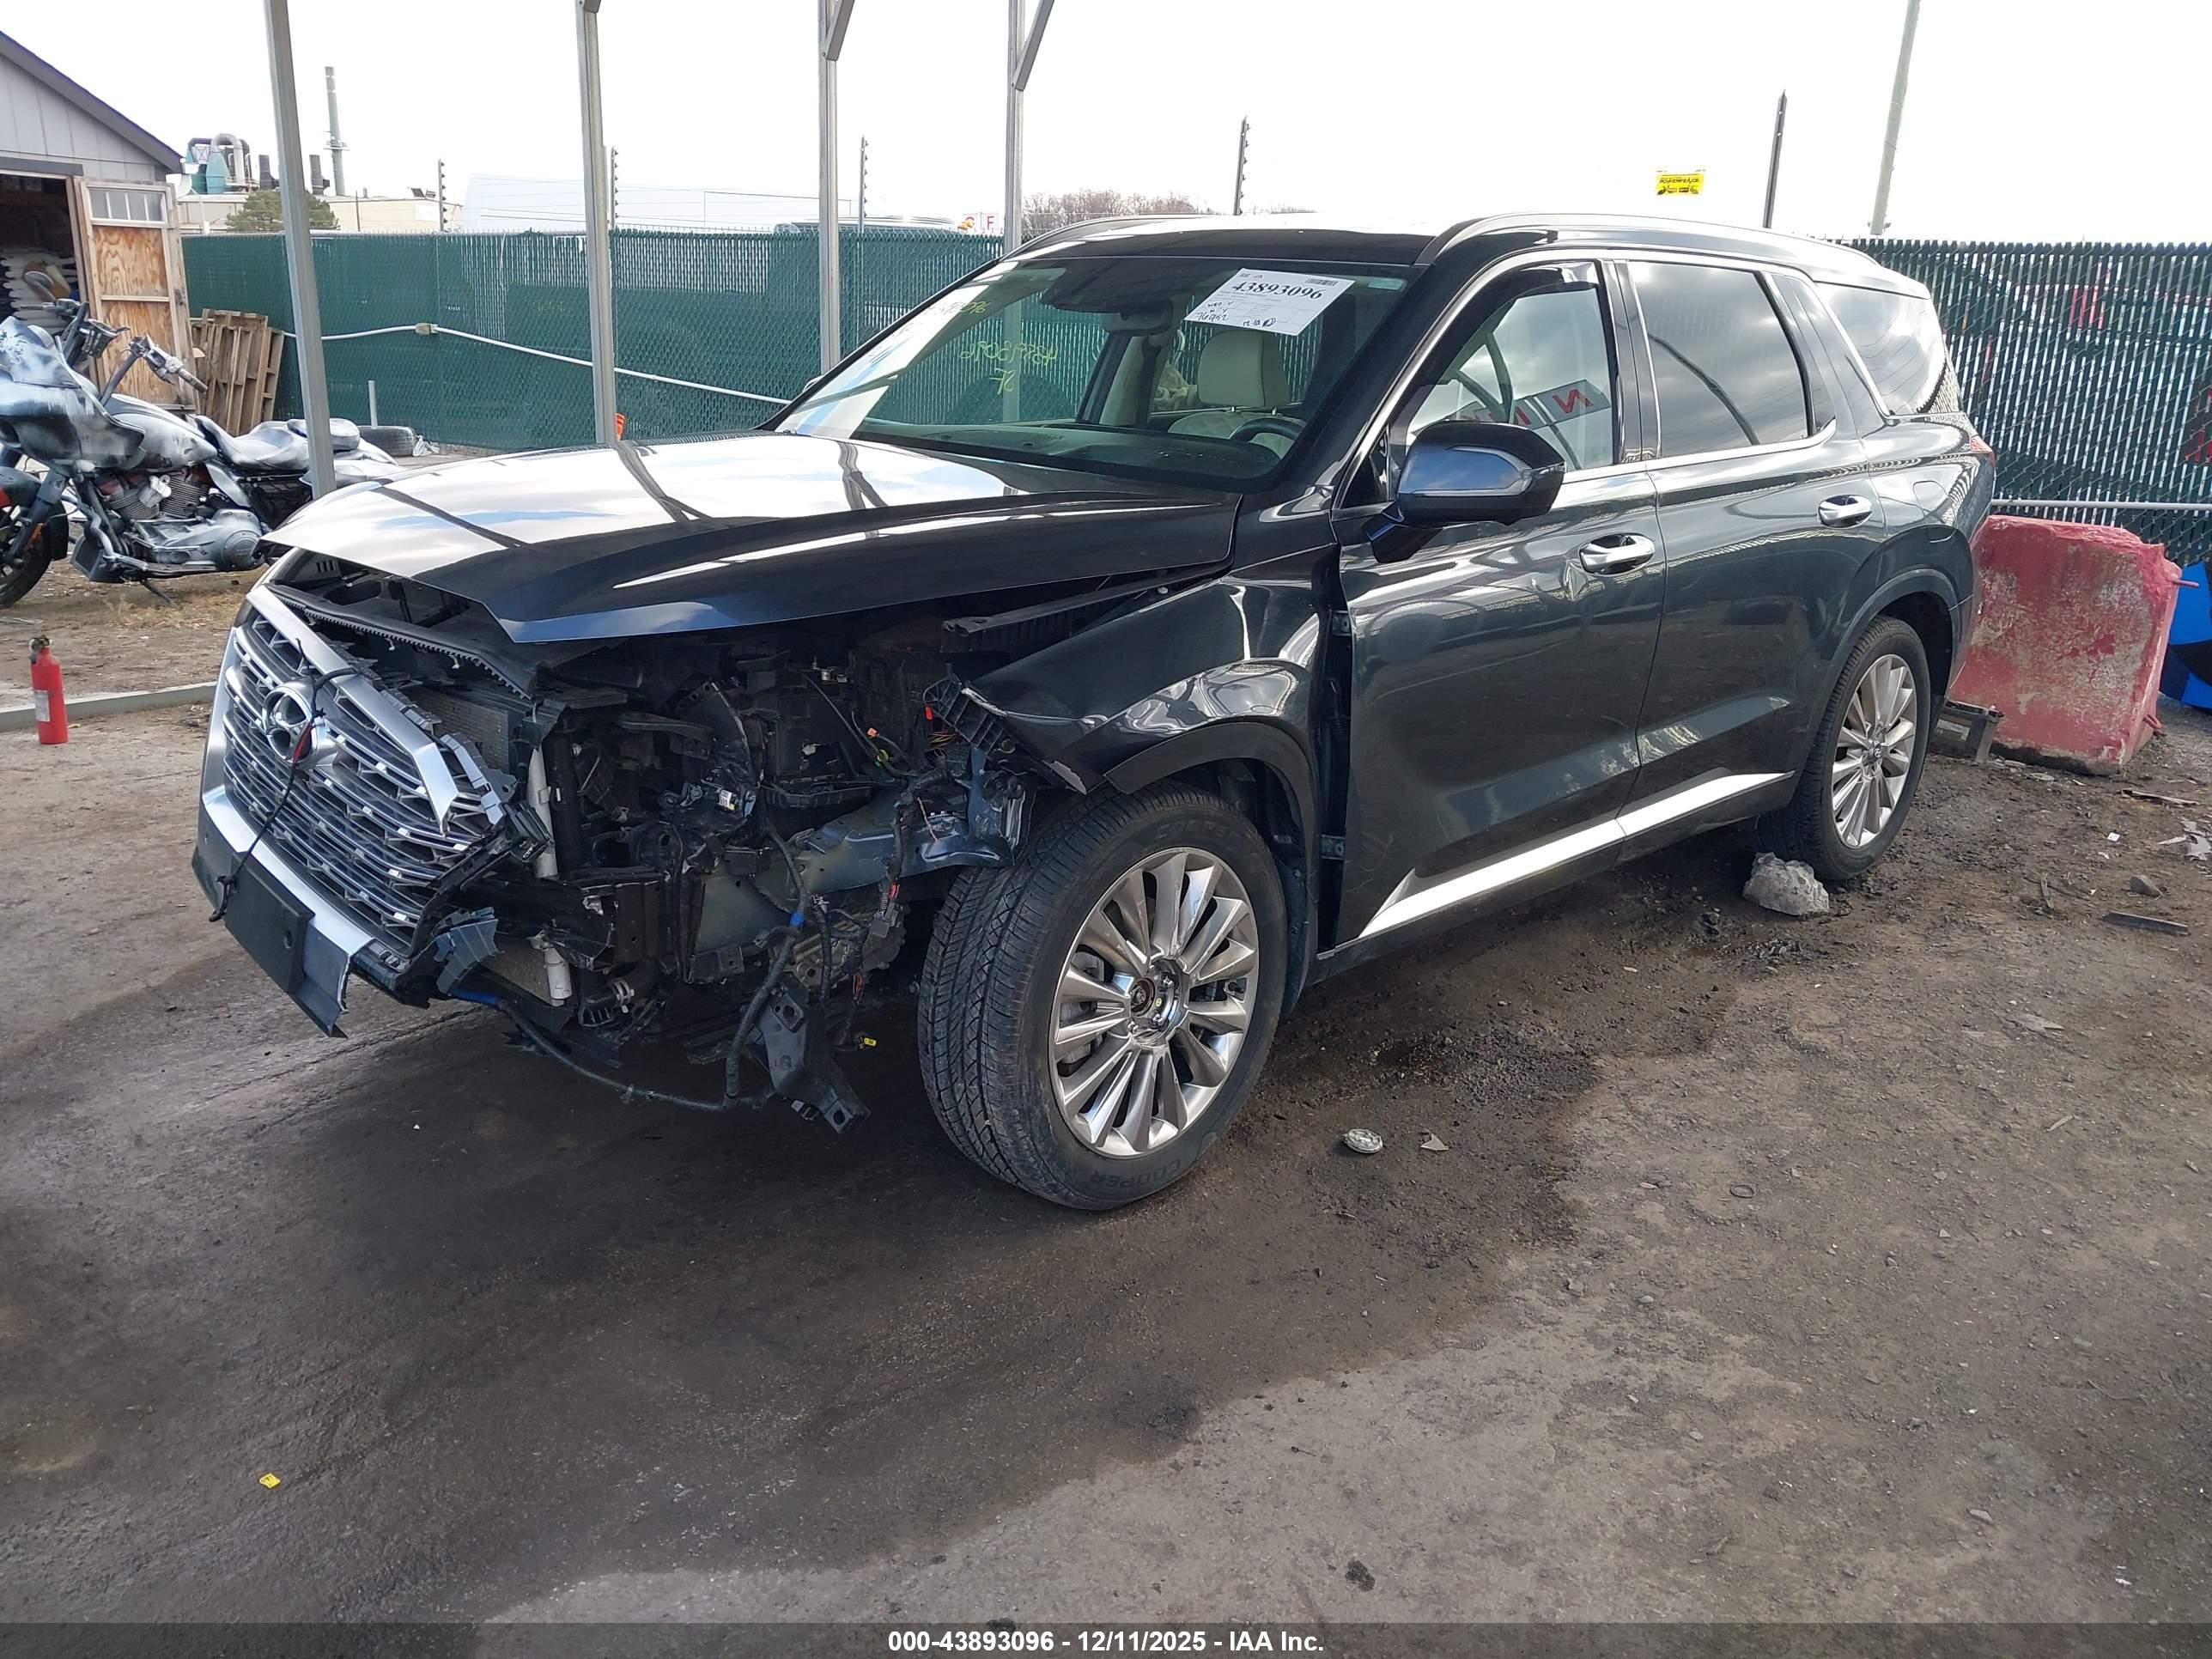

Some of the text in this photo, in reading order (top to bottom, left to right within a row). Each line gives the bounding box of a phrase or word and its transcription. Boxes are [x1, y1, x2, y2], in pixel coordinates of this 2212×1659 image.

[987, 216, 995, 230] F
[1232, 281, 1327, 300] 43893096
[1090, 1159, 1182, 1189] COOPER
